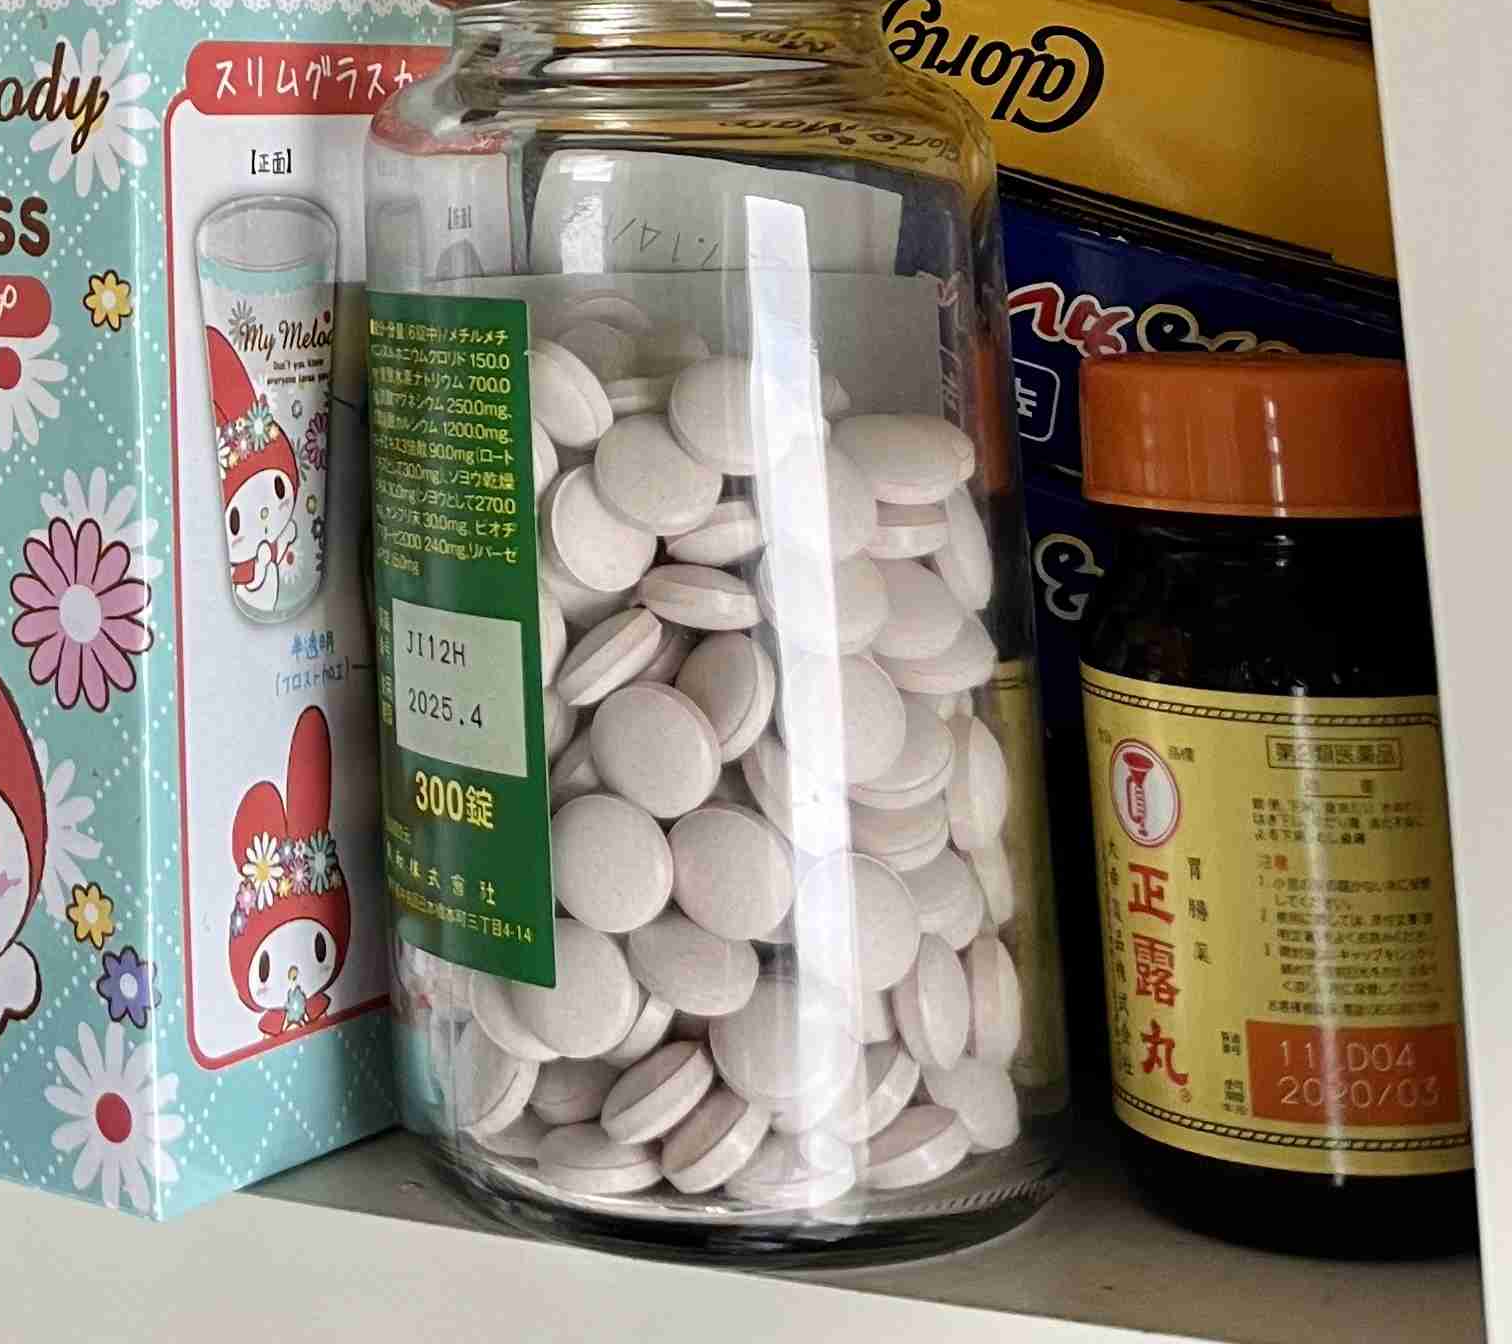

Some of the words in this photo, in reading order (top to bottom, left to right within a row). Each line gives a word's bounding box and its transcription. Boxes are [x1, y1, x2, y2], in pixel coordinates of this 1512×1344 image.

[239, 321, 276, 361] My
[470, 353, 510, 370] 150.0
[468, 375, 511, 395] 700.0
[408, 687, 483, 729] 2025.4
[416, 770, 494, 829] 300錠
[1128, 863, 1190, 1087] 正露丸
[1279, 1040, 1416, 1073] 11D04
